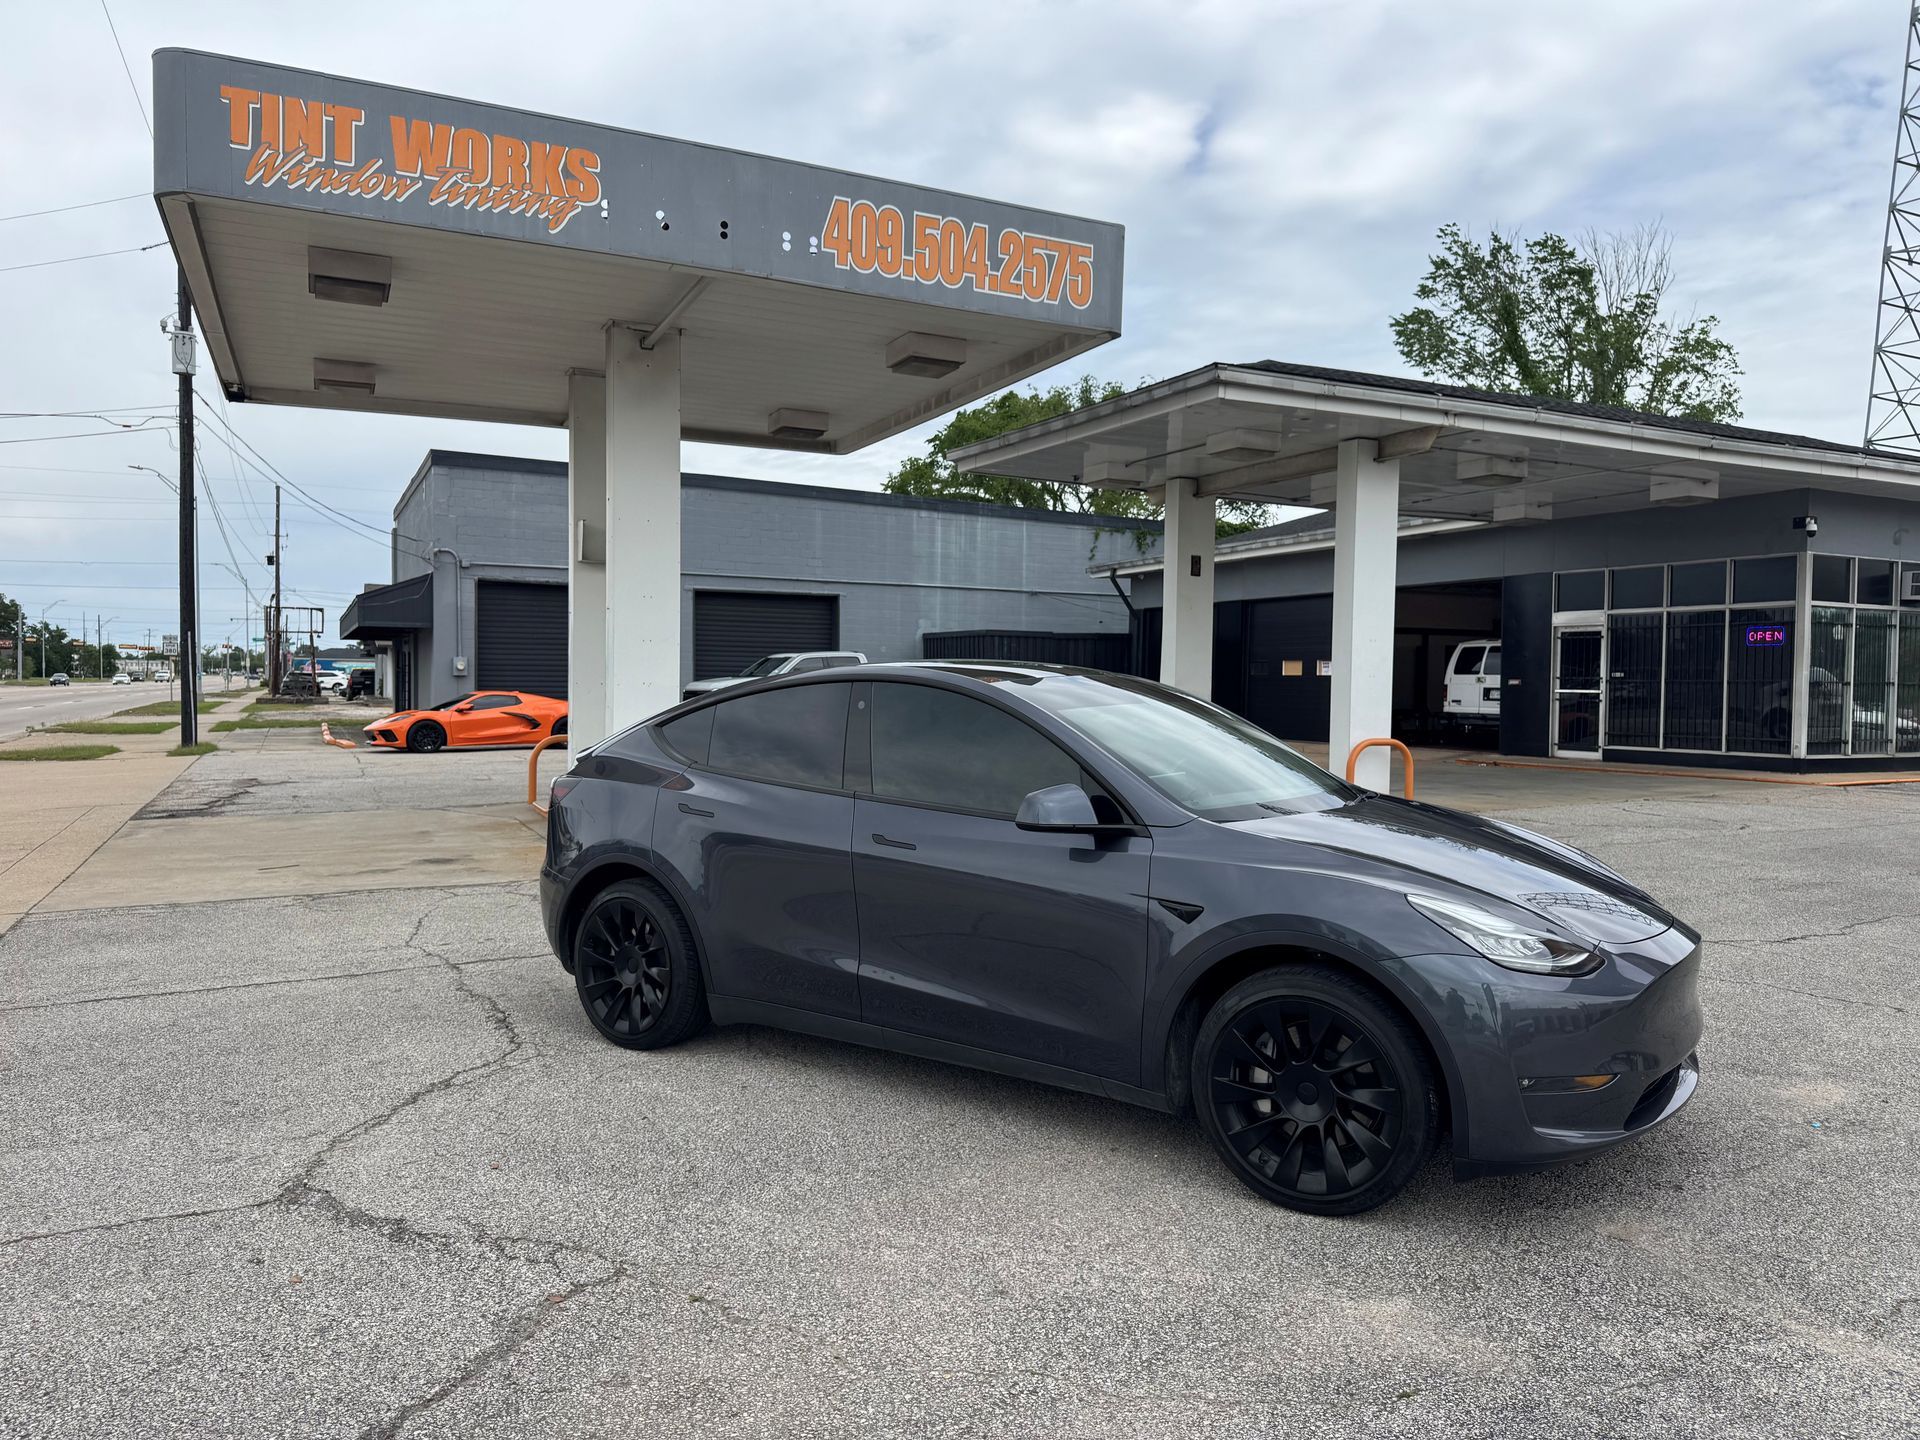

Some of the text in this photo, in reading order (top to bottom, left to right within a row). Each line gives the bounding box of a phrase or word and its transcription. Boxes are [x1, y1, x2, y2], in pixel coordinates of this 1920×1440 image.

[220, 84, 602, 207] TINT WORKS
[244, 141, 583, 235] Window Tinting
[821, 195, 1094, 309] 409.504.2575
[1749, 631, 1783, 641] OPEN
